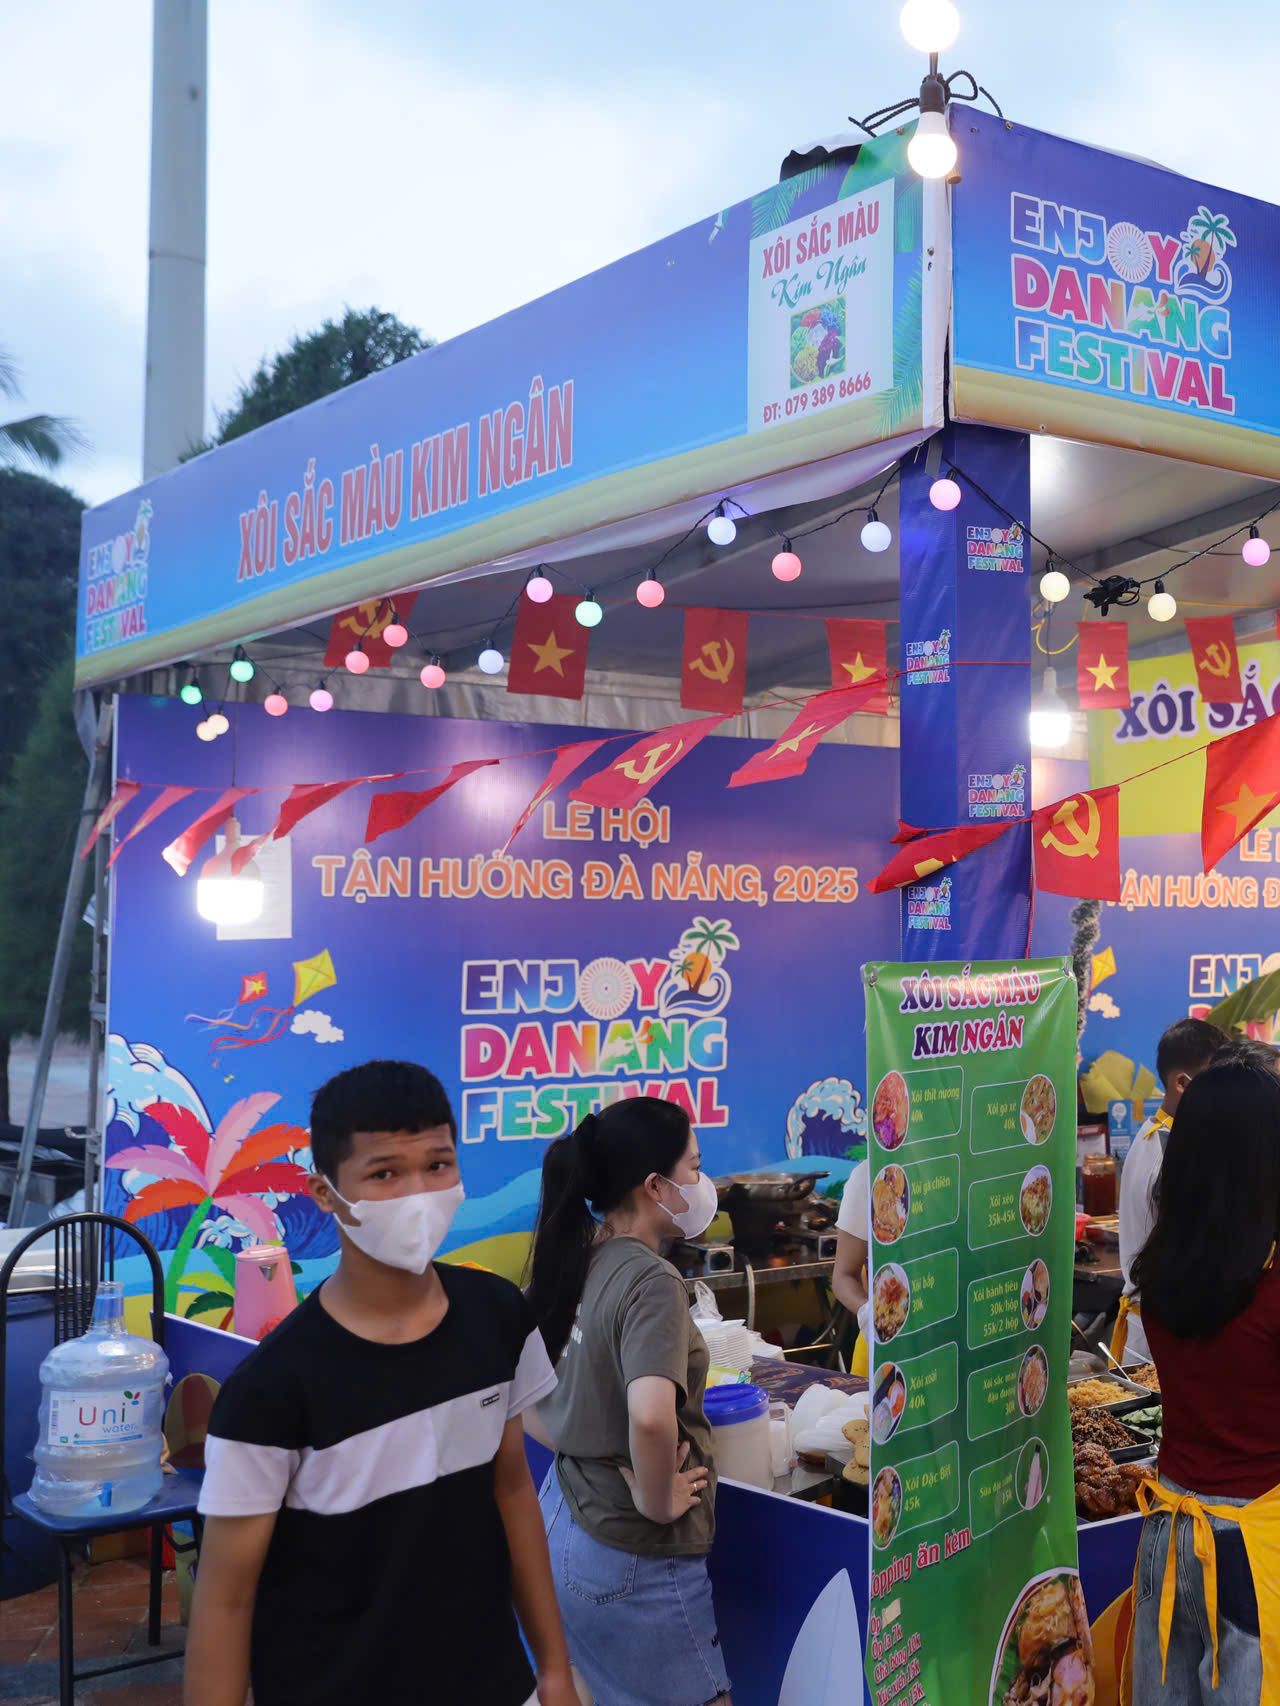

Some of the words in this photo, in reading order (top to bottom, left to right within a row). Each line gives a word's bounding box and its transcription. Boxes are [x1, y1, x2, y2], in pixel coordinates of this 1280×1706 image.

[762, 237, 790, 279] XÔI
[796, 215, 831, 265] SẮC
[838, 200, 880, 248] MÀU
[1011, 192, 1179, 285] ENJOY
[771, 273, 811, 308] Kim
[817, 256, 866, 295] Ngân
[1011, 253, 1232, 358] DANANG
[1015, 316, 1235, 415] FESTIVAL
[763, 405, 781, 423] ĐT:
[785, 393, 807, 415] 079
[812, 384, 834, 407] 389
[840, 372, 871, 398] 8666
[237, 490, 277, 582] XÔI
[283, 458, 333, 565] SẮC
[340, 444, 403, 546] MÀU
[410, 423, 470, 520] KIM
[478, 376, 575, 501] NGÂN
[967, 541, 1023, 558] DANANG
[967, 556, 1024, 573] FESTIVAL
[84, 602, 147, 652] FESTIVAL
[907, 669, 950, 686] FESTIVAL
[1116, 683, 1195, 738] XÔI
[968, 787, 1024, 804] DANANG
[968, 802, 1025, 819] FESTIVAL
[312, 848, 411, 903] TẬN
[419, 849, 573, 899] HƯỞNG
[581, 854, 644, 899] ĐÀ
[652, 851, 768, 907] NẴNG,
[773, 865, 858, 903] 2025
[1107, 868, 1161, 912] ẬN
[908, 914, 951, 930] FESTIVAL
[461, 957, 671, 1020] ENJOY
[900, 970, 943, 1013] XÔI
[948, 964, 991, 1008] SẮC
[994, 967, 1040, 1006] MÀU
[461, 1017, 728, 1081] DANANG
[912, 1021, 959, 1059] KIM
[961, 1010, 1024, 1054] NGÂN
[79, 1402, 126, 1426] Uni
[916, 1541, 940, 1568] ăn
[944, 1527, 971, 1559] kèm
